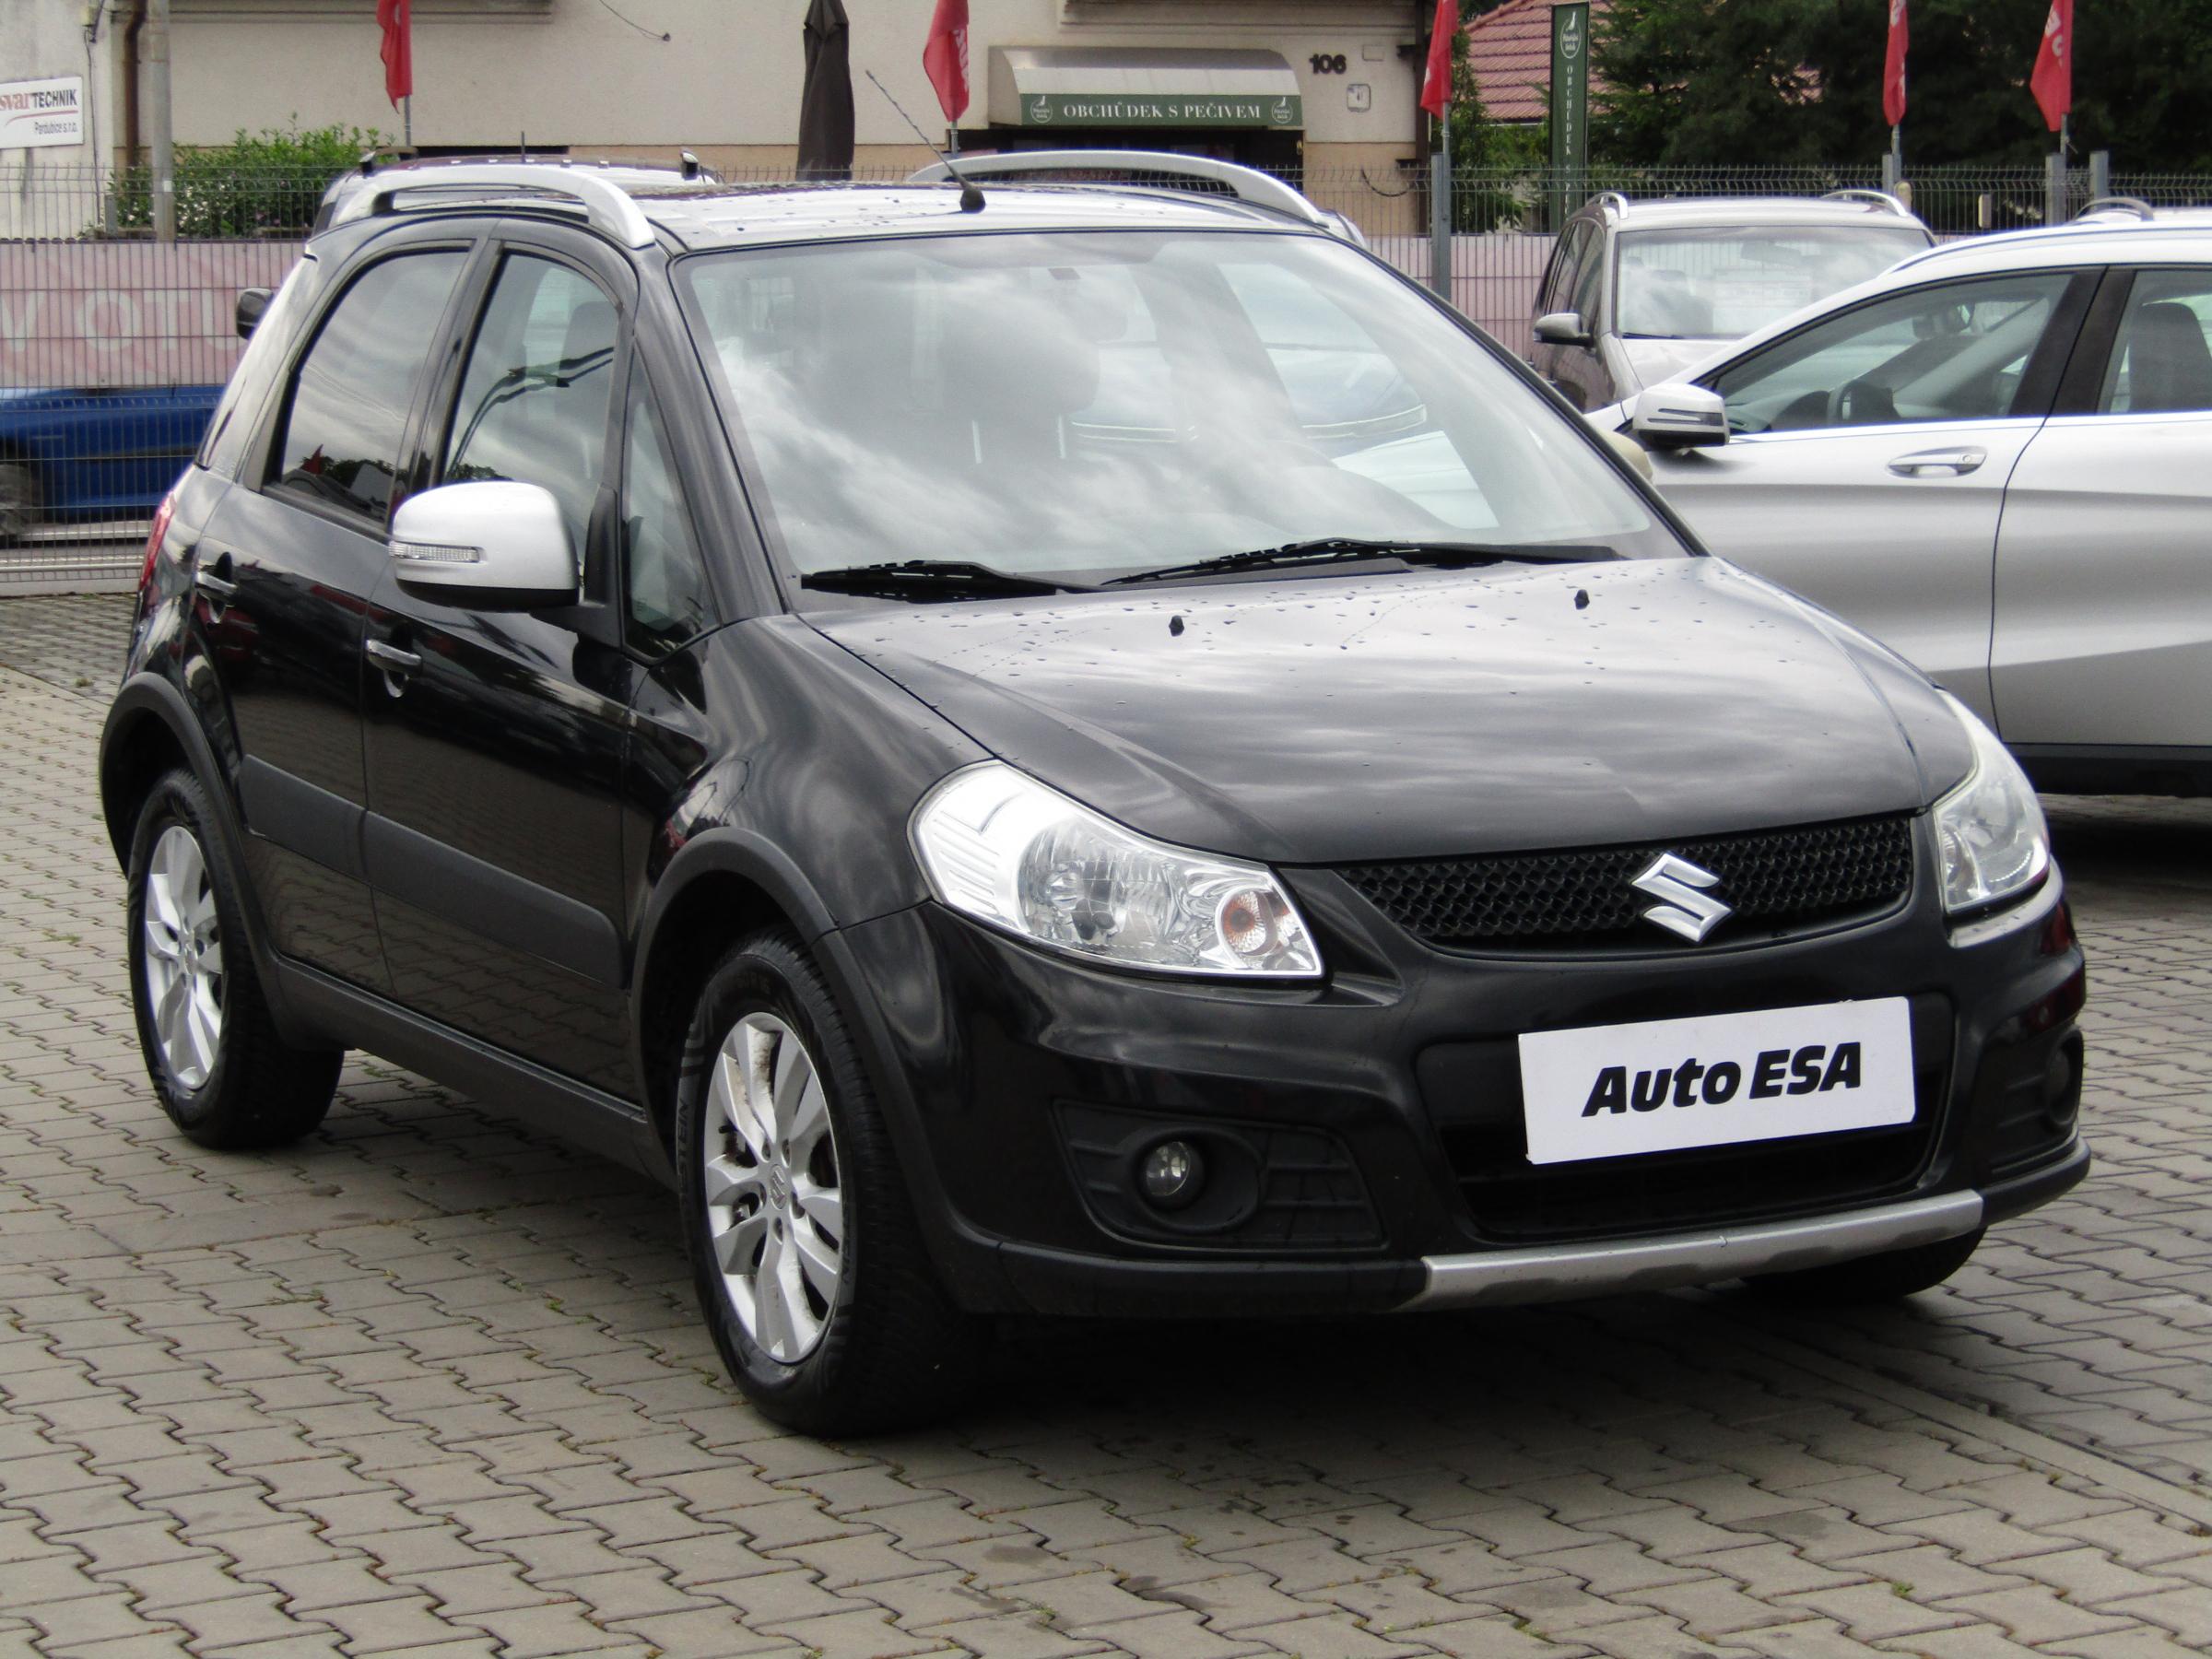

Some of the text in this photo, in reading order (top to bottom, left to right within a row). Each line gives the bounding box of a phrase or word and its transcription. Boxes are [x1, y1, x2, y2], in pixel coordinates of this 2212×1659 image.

[1308, 53, 1347, 75] 106
[1063, 101, 1163, 118] OBCHŮDEK
[1168, 104, 1179, 118] S
[1184, 102, 1261, 118] PEČIVEM
[1581, 1041, 1862, 1118] Auto ESA
